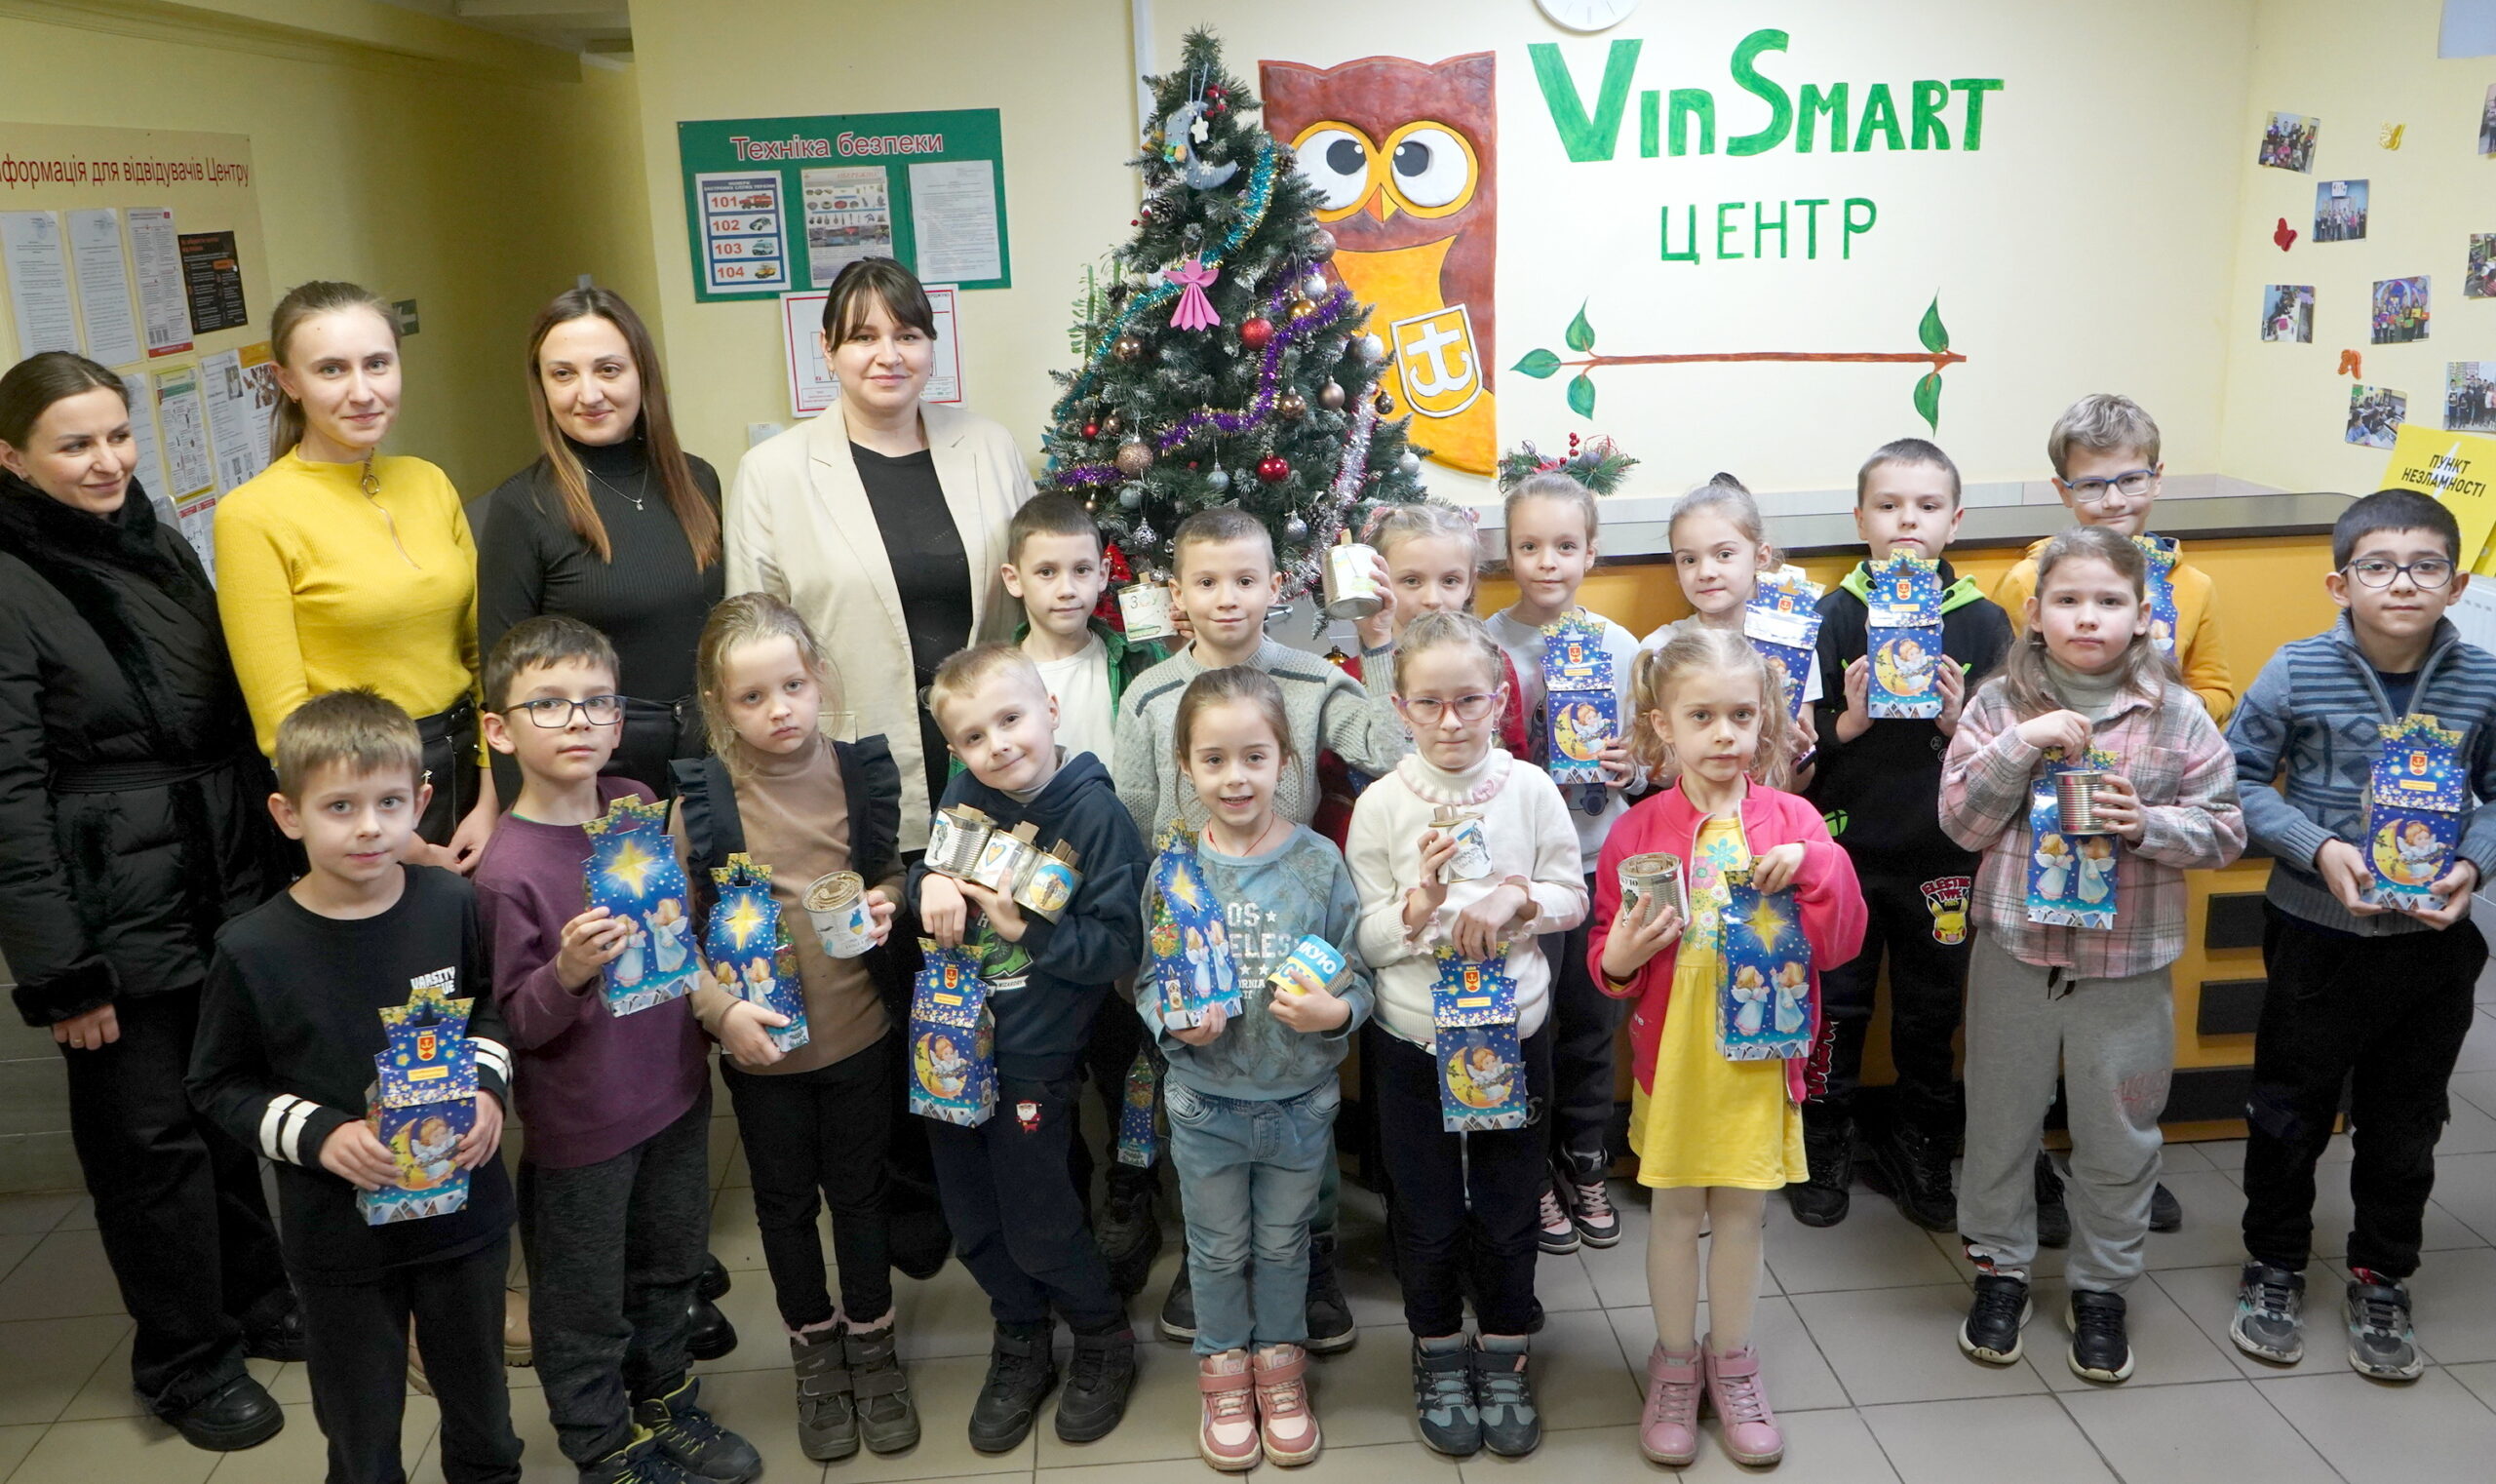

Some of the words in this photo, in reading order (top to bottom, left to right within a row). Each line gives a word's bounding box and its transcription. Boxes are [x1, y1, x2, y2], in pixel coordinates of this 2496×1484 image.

[729, 135, 832, 162] Техніка
[837, 131, 944, 157] безпеки
[0, 153, 87, 189] формація
[92, 160, 120, 186] для
[123, 155, 205, 188] відвідувачів
[206, 156, 250, 188] Центру
[712, 196, 737, 208] 101
[713, 219, 740, 232] 102
[1660, 197, 1878, 265] ЦЕНТР
[715, 243, 743, 255] 103
[717, 266, 745, 279] 104
[2429, 454, 2472, 475] ПУНКТ
[2400, 467, 2487, 498] НЕЗЛАМНОСТІ
[1227, 902, 1261, 927] OS
[1228, 932, 1292, 958] ELES
[410, 965, 456, 990] VARSITY
